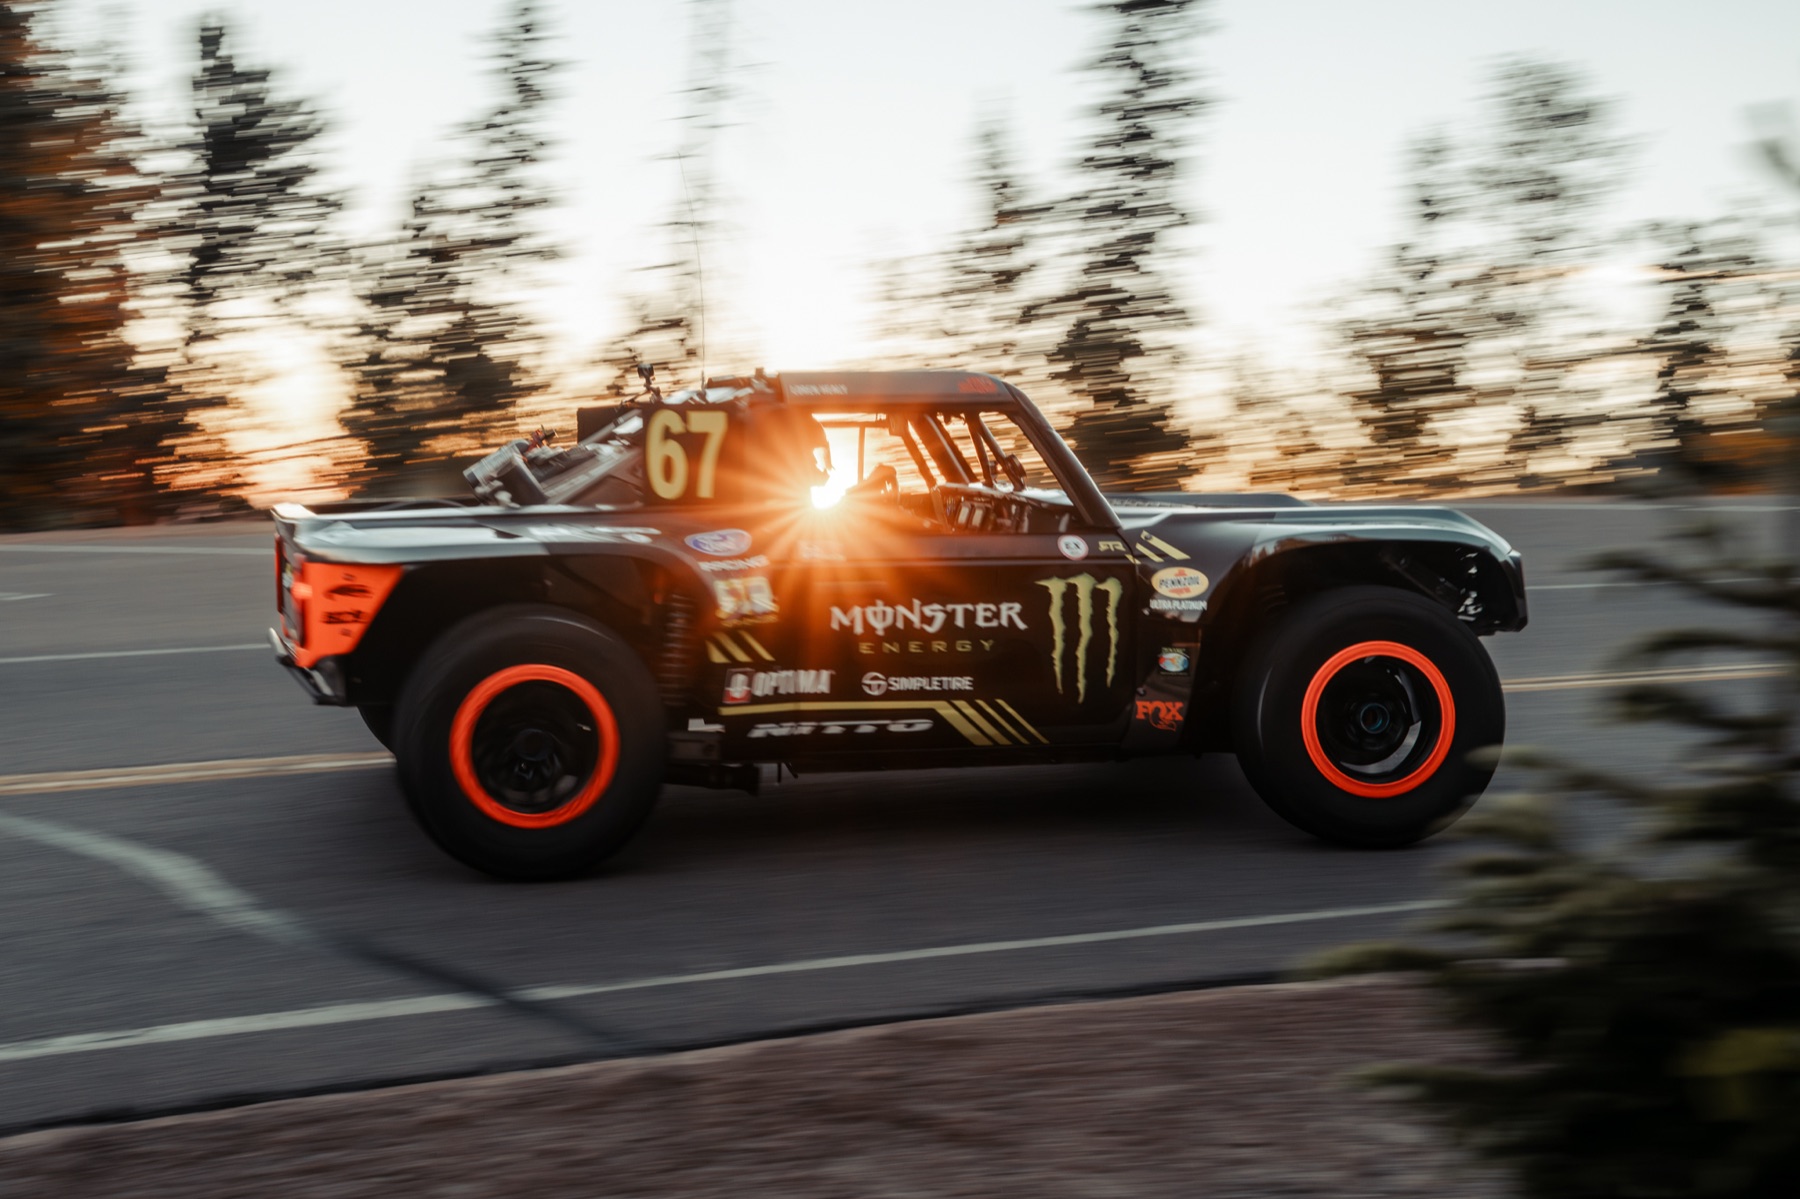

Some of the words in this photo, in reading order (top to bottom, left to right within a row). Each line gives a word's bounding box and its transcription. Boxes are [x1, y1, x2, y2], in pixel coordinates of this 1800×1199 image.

[646, 409, 728, 499] 67
[829, 598, 1029, 636] MONSTER
[858, 639, 996, 654] ENERGY
[1135, 701, 1184, 728] FOX
